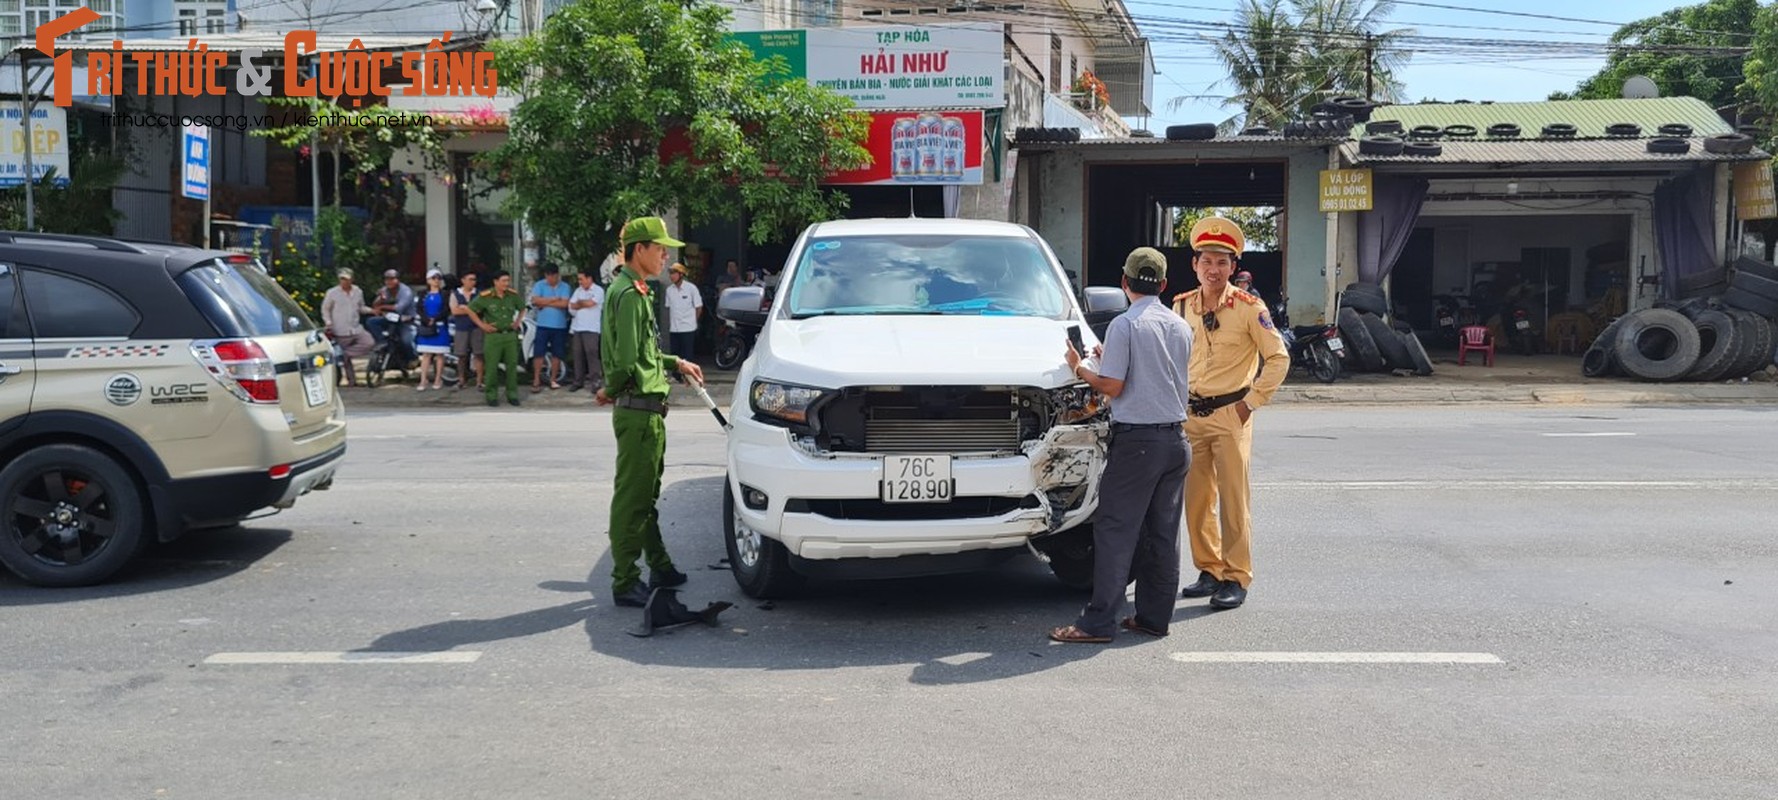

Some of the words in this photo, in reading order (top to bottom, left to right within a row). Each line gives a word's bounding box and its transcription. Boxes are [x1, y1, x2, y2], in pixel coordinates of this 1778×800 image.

[876, 31, 900, 46] TẠP
[860, 47, 895, 74] HẢI
[902, 50, 949, 73] NHƯ
[849, 77, 866, 89] BÁN
[868, 78, 881, 89] BIA
[889, 76, 912, 88] NƯỚC
[913, 74, 930, 88] GIẢI
[955, 74, 972, 87] CÁC
[974, 75, 993, 89] LOẠI
[150, 383, 208, 396] WRC
[900, 457, 934, 478] 76C
[887, 479, 949, 500] 128.90
